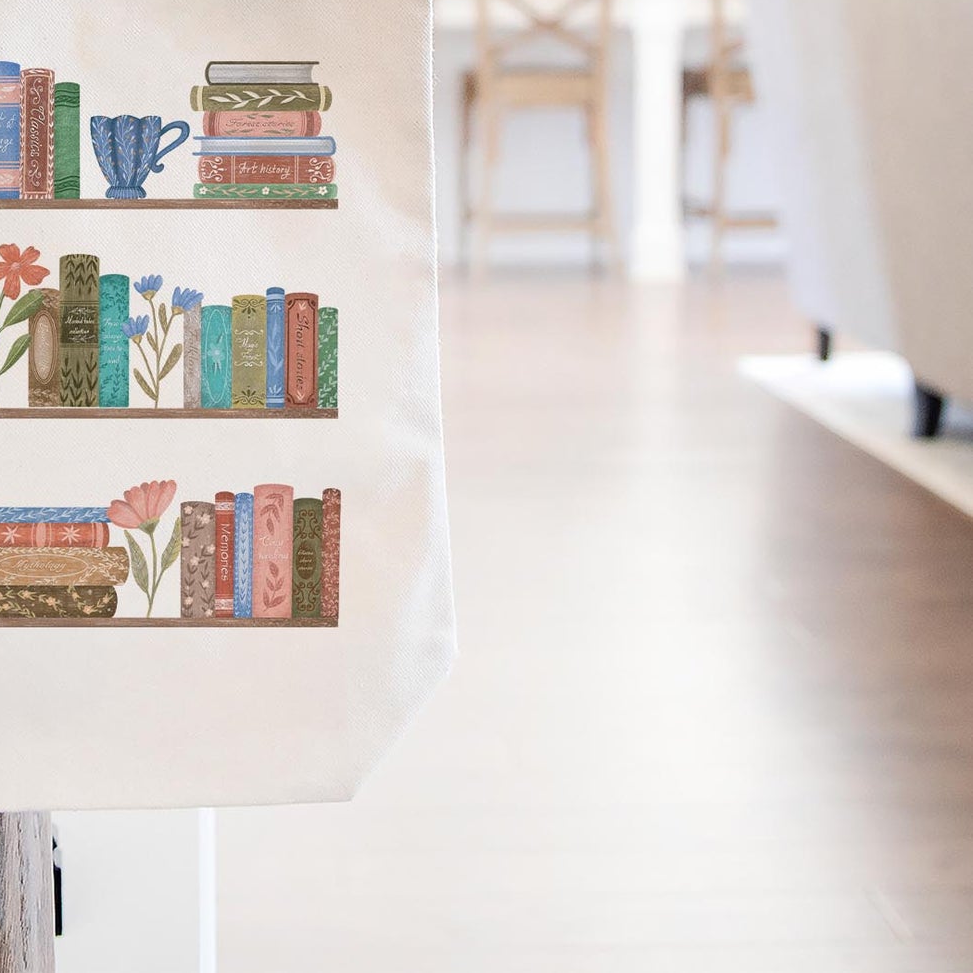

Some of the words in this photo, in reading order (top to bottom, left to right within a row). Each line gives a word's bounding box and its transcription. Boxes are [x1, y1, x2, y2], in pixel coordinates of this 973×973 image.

[30, 105, 45, 157] Classics
[238, 162, 258, 174] Art
[259, 163, 291, 179] history
[296, 313, 310, 348] Short
[296, 352, 307, 391] stories
[11, 559, 68, 572] Mythology
[220, 523, 230, 582] Memories
